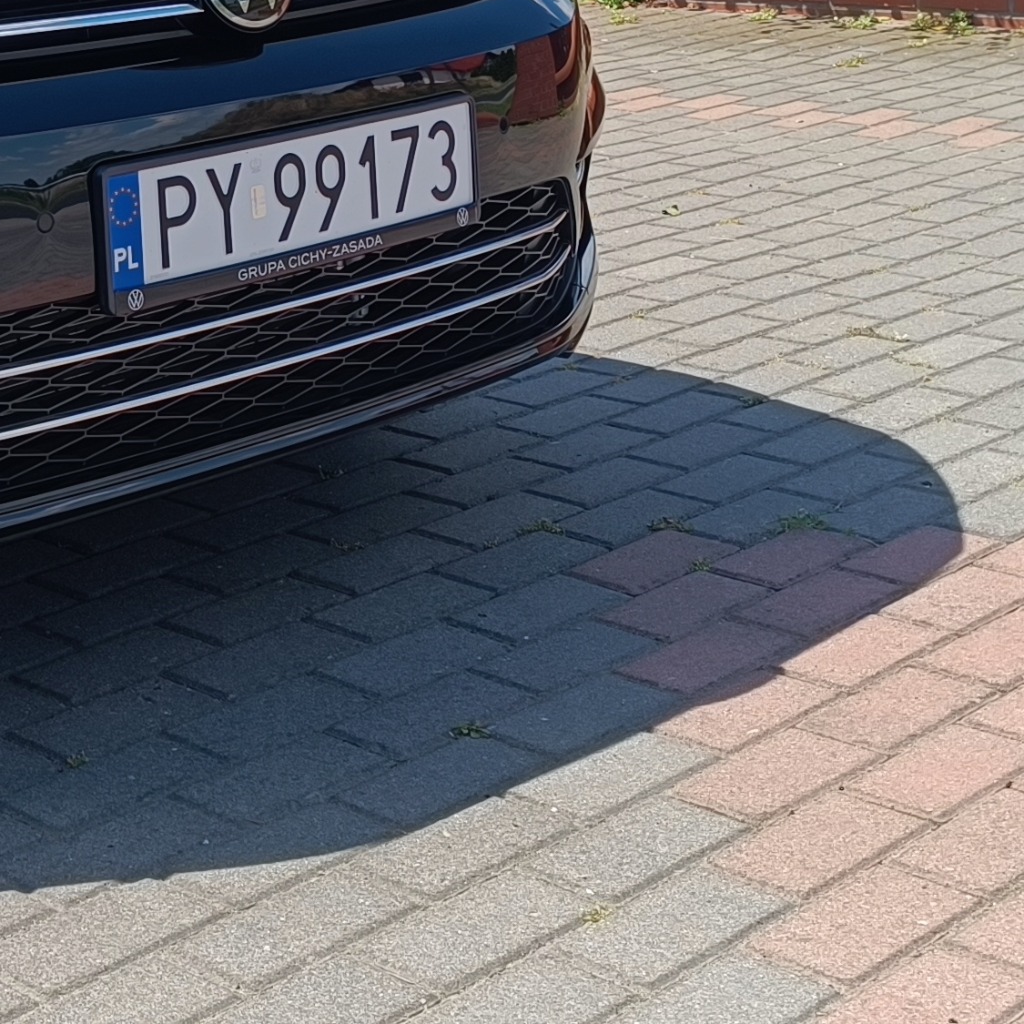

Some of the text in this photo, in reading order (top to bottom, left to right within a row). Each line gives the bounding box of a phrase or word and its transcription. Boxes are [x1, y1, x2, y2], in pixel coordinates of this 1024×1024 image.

[157, 120, 457, 270] PY 99173
[114, 245, 139, 273] PL
[238, 234, 383, 281] GRUPA CICHY-ZASADA
